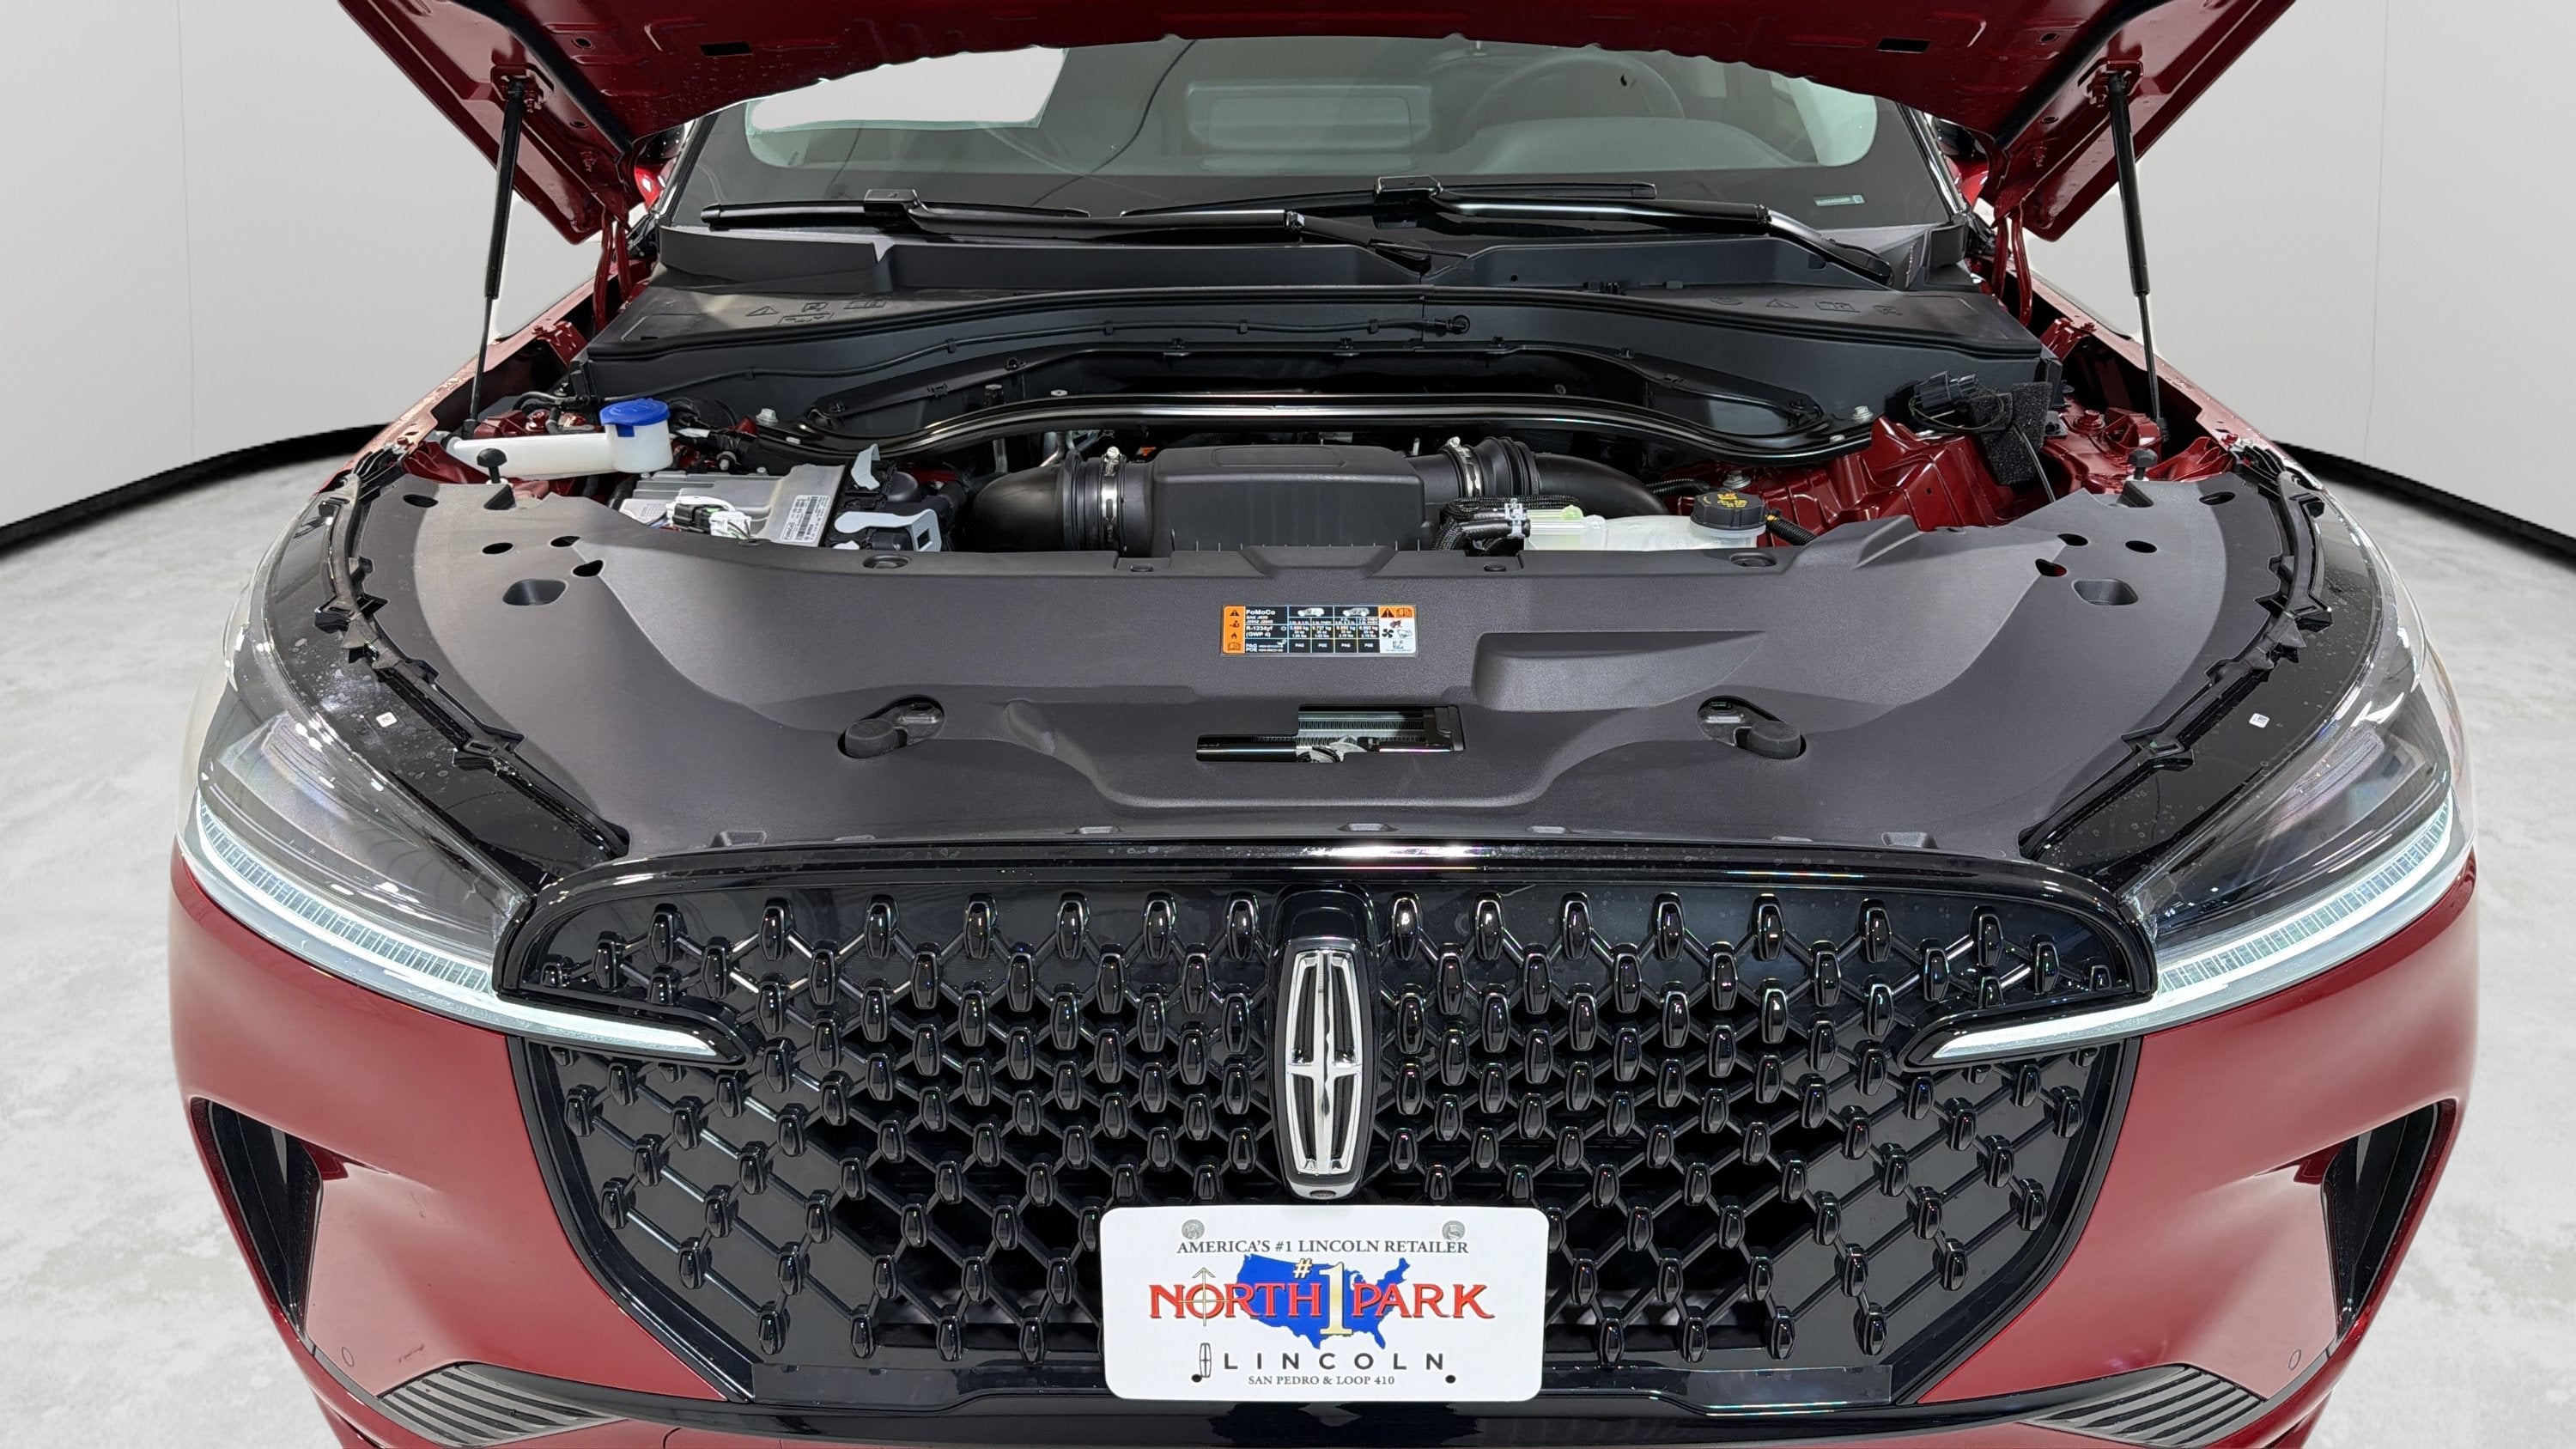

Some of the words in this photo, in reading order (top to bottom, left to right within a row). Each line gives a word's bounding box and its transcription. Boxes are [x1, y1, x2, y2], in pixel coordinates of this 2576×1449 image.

[1176, 1240, 1270, 1253] AMERICA'S
[1275, 1240, 1292, 1252] #1
[1297, 1239, 1379, 1252] LINCOLN
[1384, 1240, 1469, 1253] RETAILER
[1148, 1282, 1322, 1319] NORTH
[1352, 1282, 1496, 1319] PARK
[1224, 1353, 1443, 1370] LINCOLN
[1248, 1375, 1273, 1385] SAN
[1276, 1375, 1320, 1385] PEDRO
[1322, 1375, 1333, 1385] &
[1336, 1375, 1371, 1385] LOOP
[1374, 1375, 1395, 1385] 410
